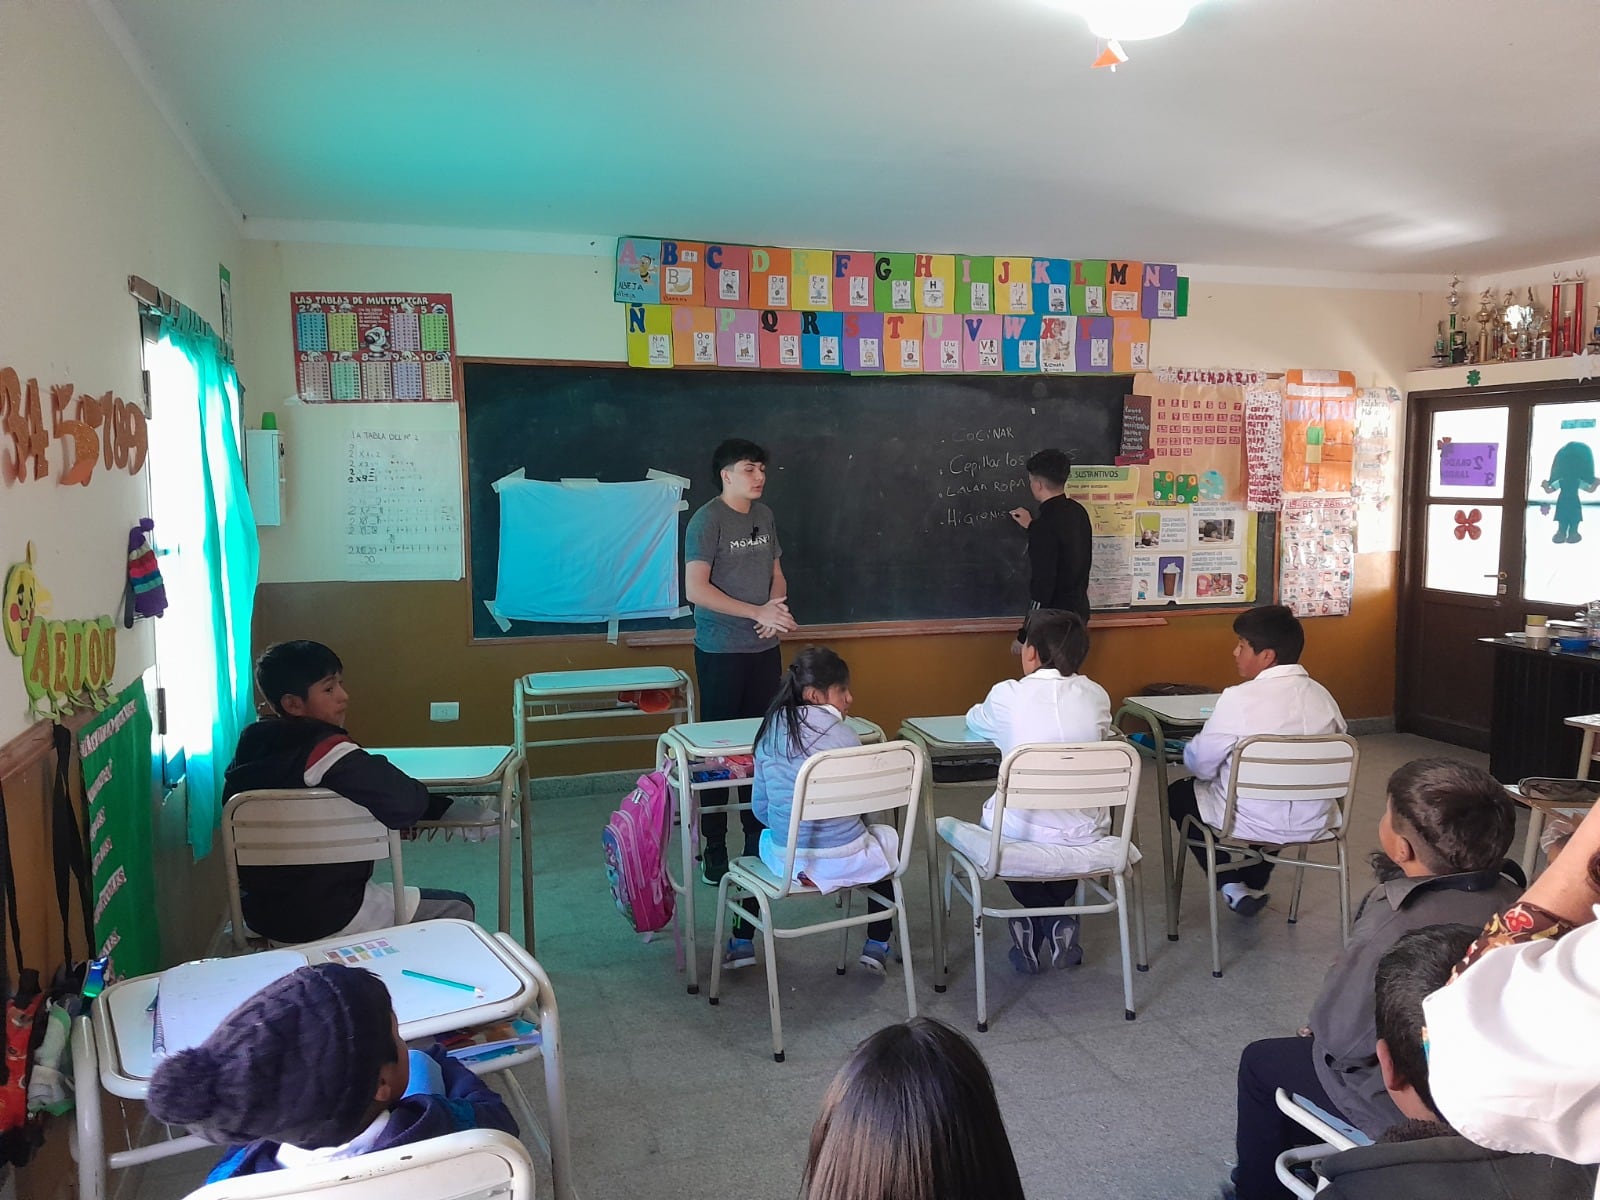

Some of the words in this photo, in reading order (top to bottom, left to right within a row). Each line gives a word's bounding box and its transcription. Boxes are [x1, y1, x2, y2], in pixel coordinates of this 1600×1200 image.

[618, 240, 638, 264] A
[662, 242, 678, 265] B
[707, 246, 723, 269] C
[752, 250, 770, 272] D
[794, 251, 808, 275] E
[835, 255, 851, 278] F
[875, 257, 892, 280] G
[915, 255, 933, 277] H
[962, 260, 970, 283] I
[998, 261, 1010, 284] J
[1034, 261, 1050, 284] K
[1074, 262, 1087, 285] L
[1109, 263, 1128, 284] M
[1144, 265, 1160, 287] N
[295, 296, 312, 304] LAS
[315, 296, 349, 304] TABLAS
[366, 297, 429, 305] MULTIPLICAR
[720, 309, 735, 332] P
[761, 310, 778, 333] Q
[802, 312, 820, 335] R
[845, 314, 859, 337] S
[887, 316, 904, 339] T
[926, 315, 944, 339] U
[965, 318, 983, 342] V
[1004, 317, 1025, 339] W
[1041, 318, 1055, 339] X
[1080, 318, 1095, 340] Y
[950, 452, 1000, 477] Cepillar
[1006, 452, 1025, 467] los
[30, 623, 117, 692] AEIOU
